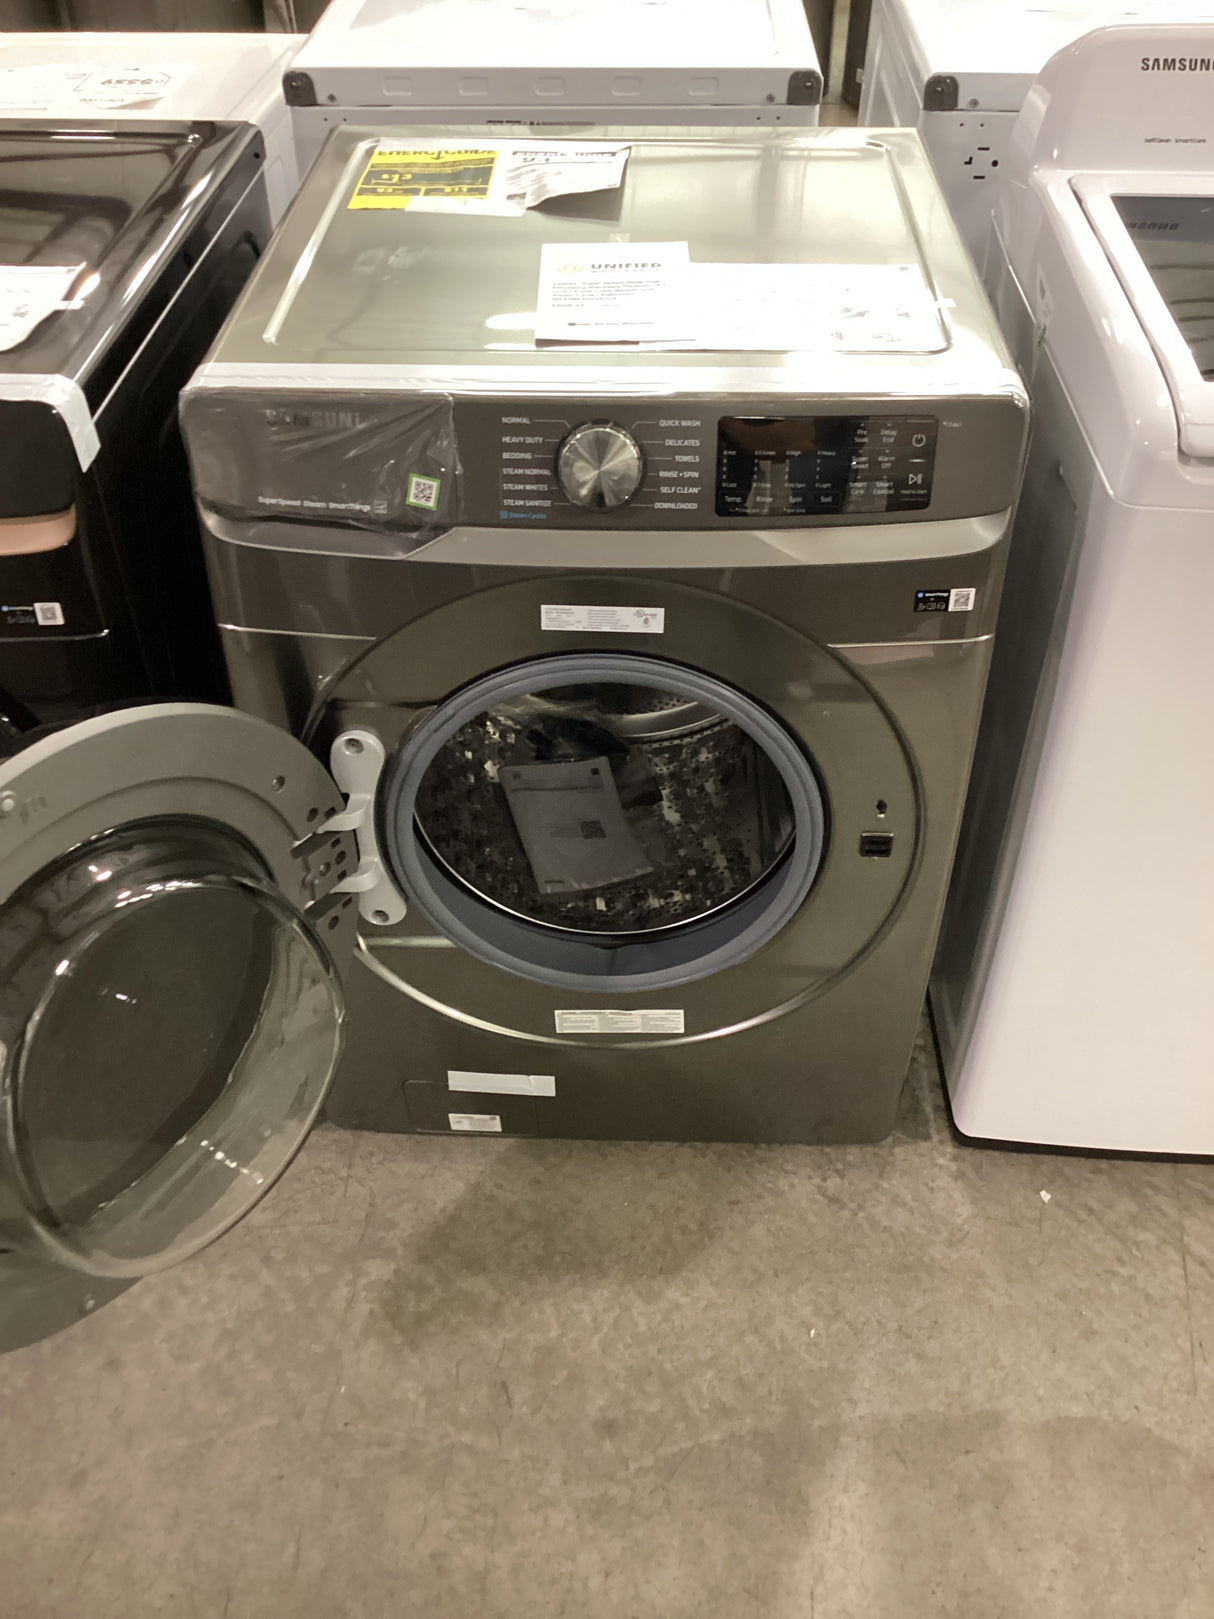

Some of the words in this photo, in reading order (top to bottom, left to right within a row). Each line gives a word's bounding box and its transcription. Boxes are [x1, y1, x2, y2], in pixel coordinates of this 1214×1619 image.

[1141, 57, 1214, 72] SAMSUN
[501, 416, 531, 425] NORMAL
[659, 419, 680, 427] QUICK
[502, 436, 525, 444] HEAVY
[525, 436, 544, 444] DUTY
[664, 439, 700, 447] DELICATES
[502, 452, 532, 460] BEDDING
[675, 455, 700, 463] TOWELS
[502, 467, 524, 475] STEAM
[524, 468, 551, 476] NORMAL
[660, 486, 676, 494] SELF
[525, 499, 552, 507] SANITIZE
